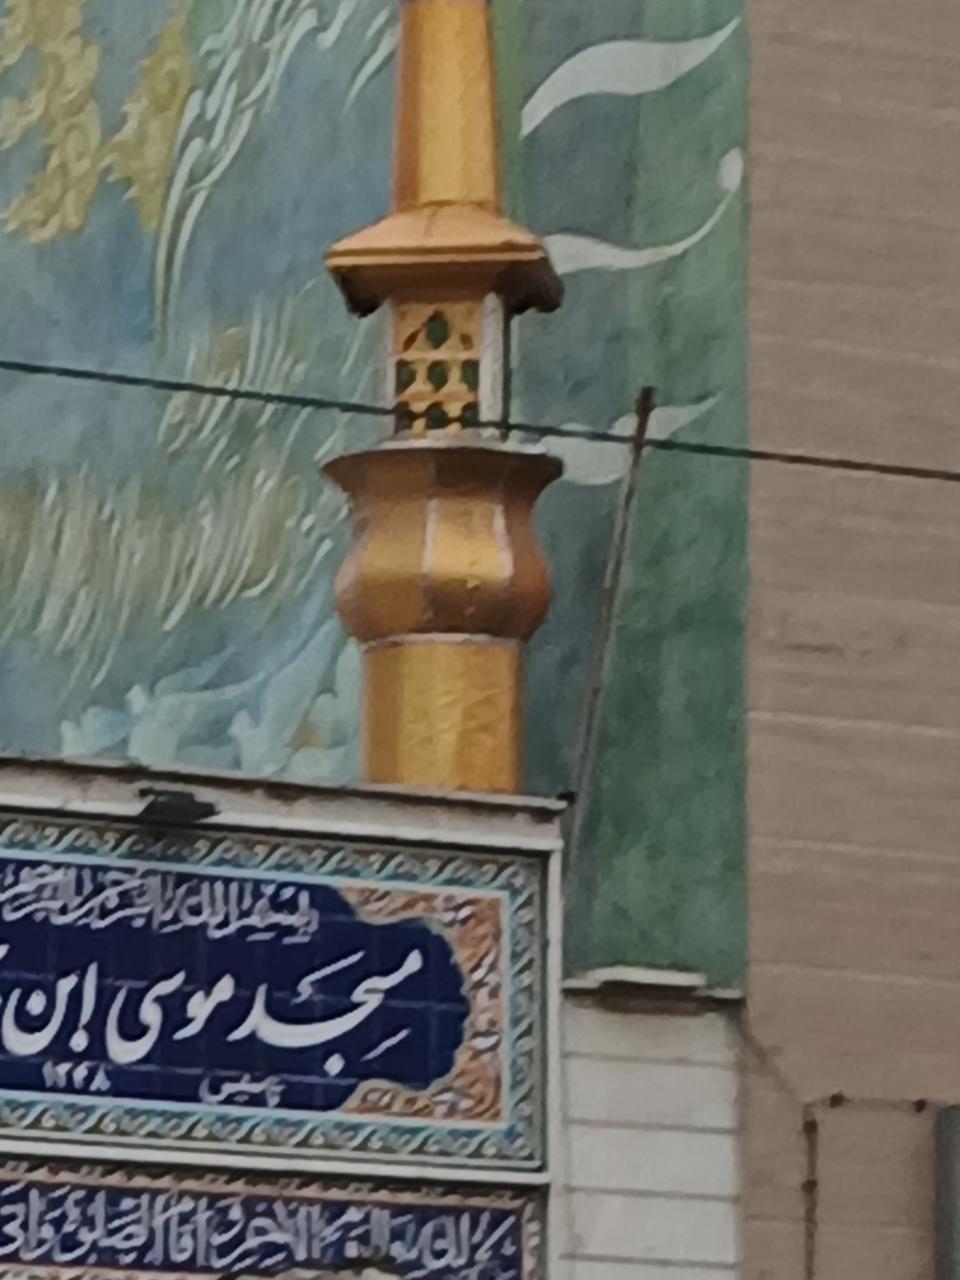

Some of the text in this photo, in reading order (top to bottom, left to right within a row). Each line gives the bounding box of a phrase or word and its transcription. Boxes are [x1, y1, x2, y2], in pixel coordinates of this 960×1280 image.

[1, 959, 99, 1057] ابن
[104, 969, 236, 1065] موسی
[225, 948, 424, 1077] مسجد
